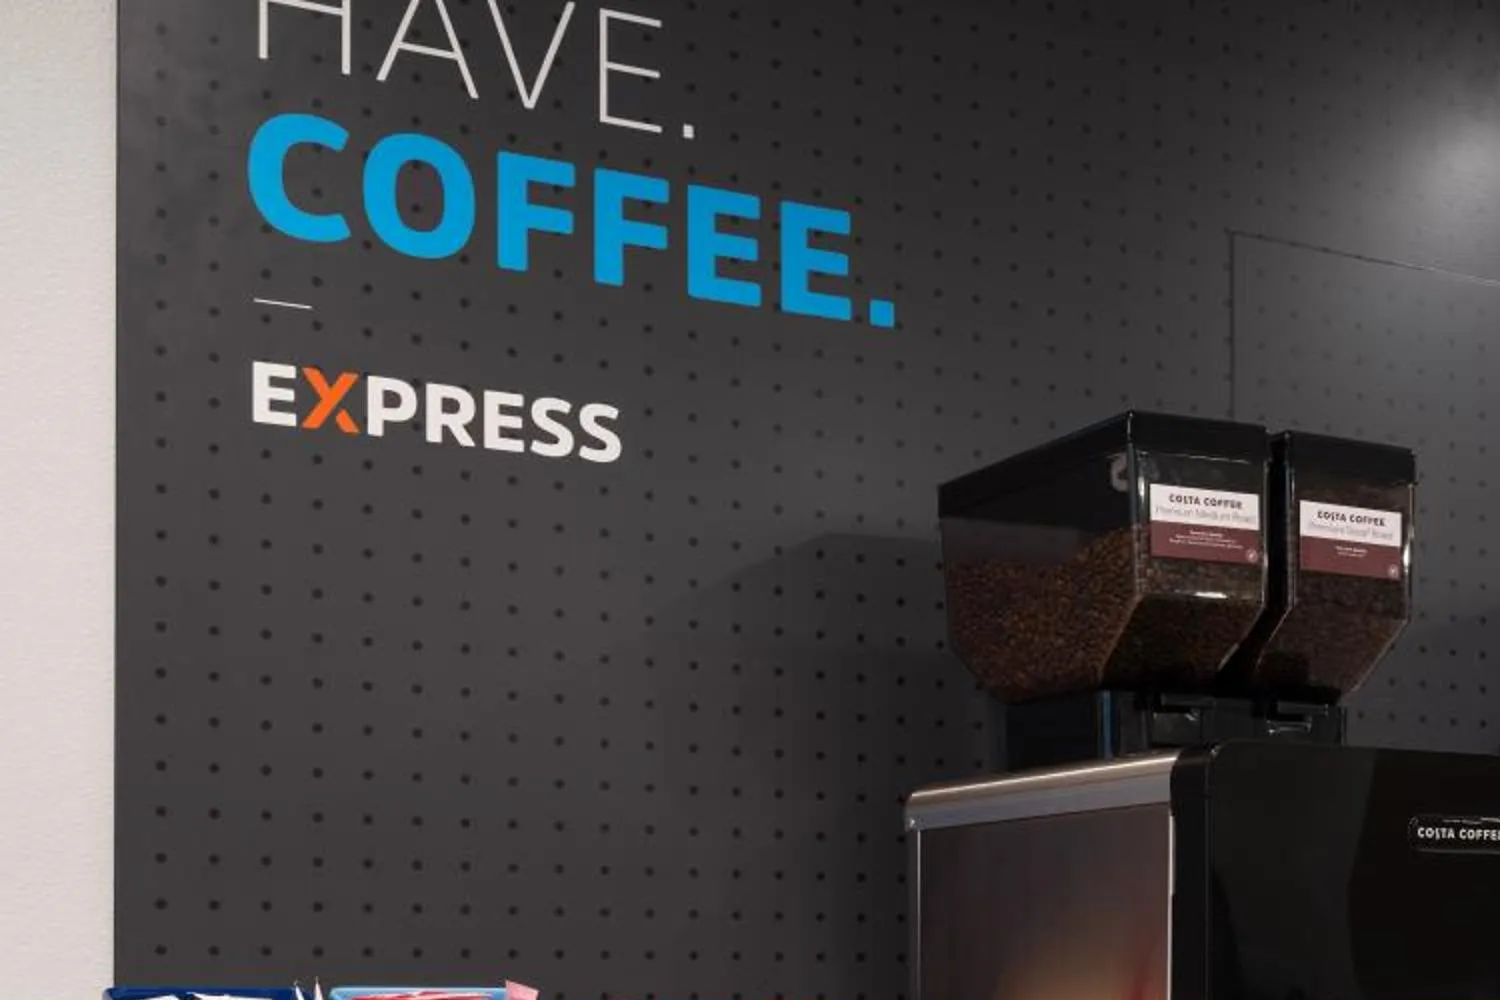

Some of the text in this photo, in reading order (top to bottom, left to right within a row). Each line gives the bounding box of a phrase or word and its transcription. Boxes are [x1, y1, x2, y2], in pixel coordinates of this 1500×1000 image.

[246, 112, 895, 328] COFFEE.
[252, 360, 623, 464] EXPRESS
[1168, 493, 1243, 509] COSTA COFFEE
[1317, 511, 1385, 527] COSTA COFFEE
[1417, 827, 1455, 840] COSTA
